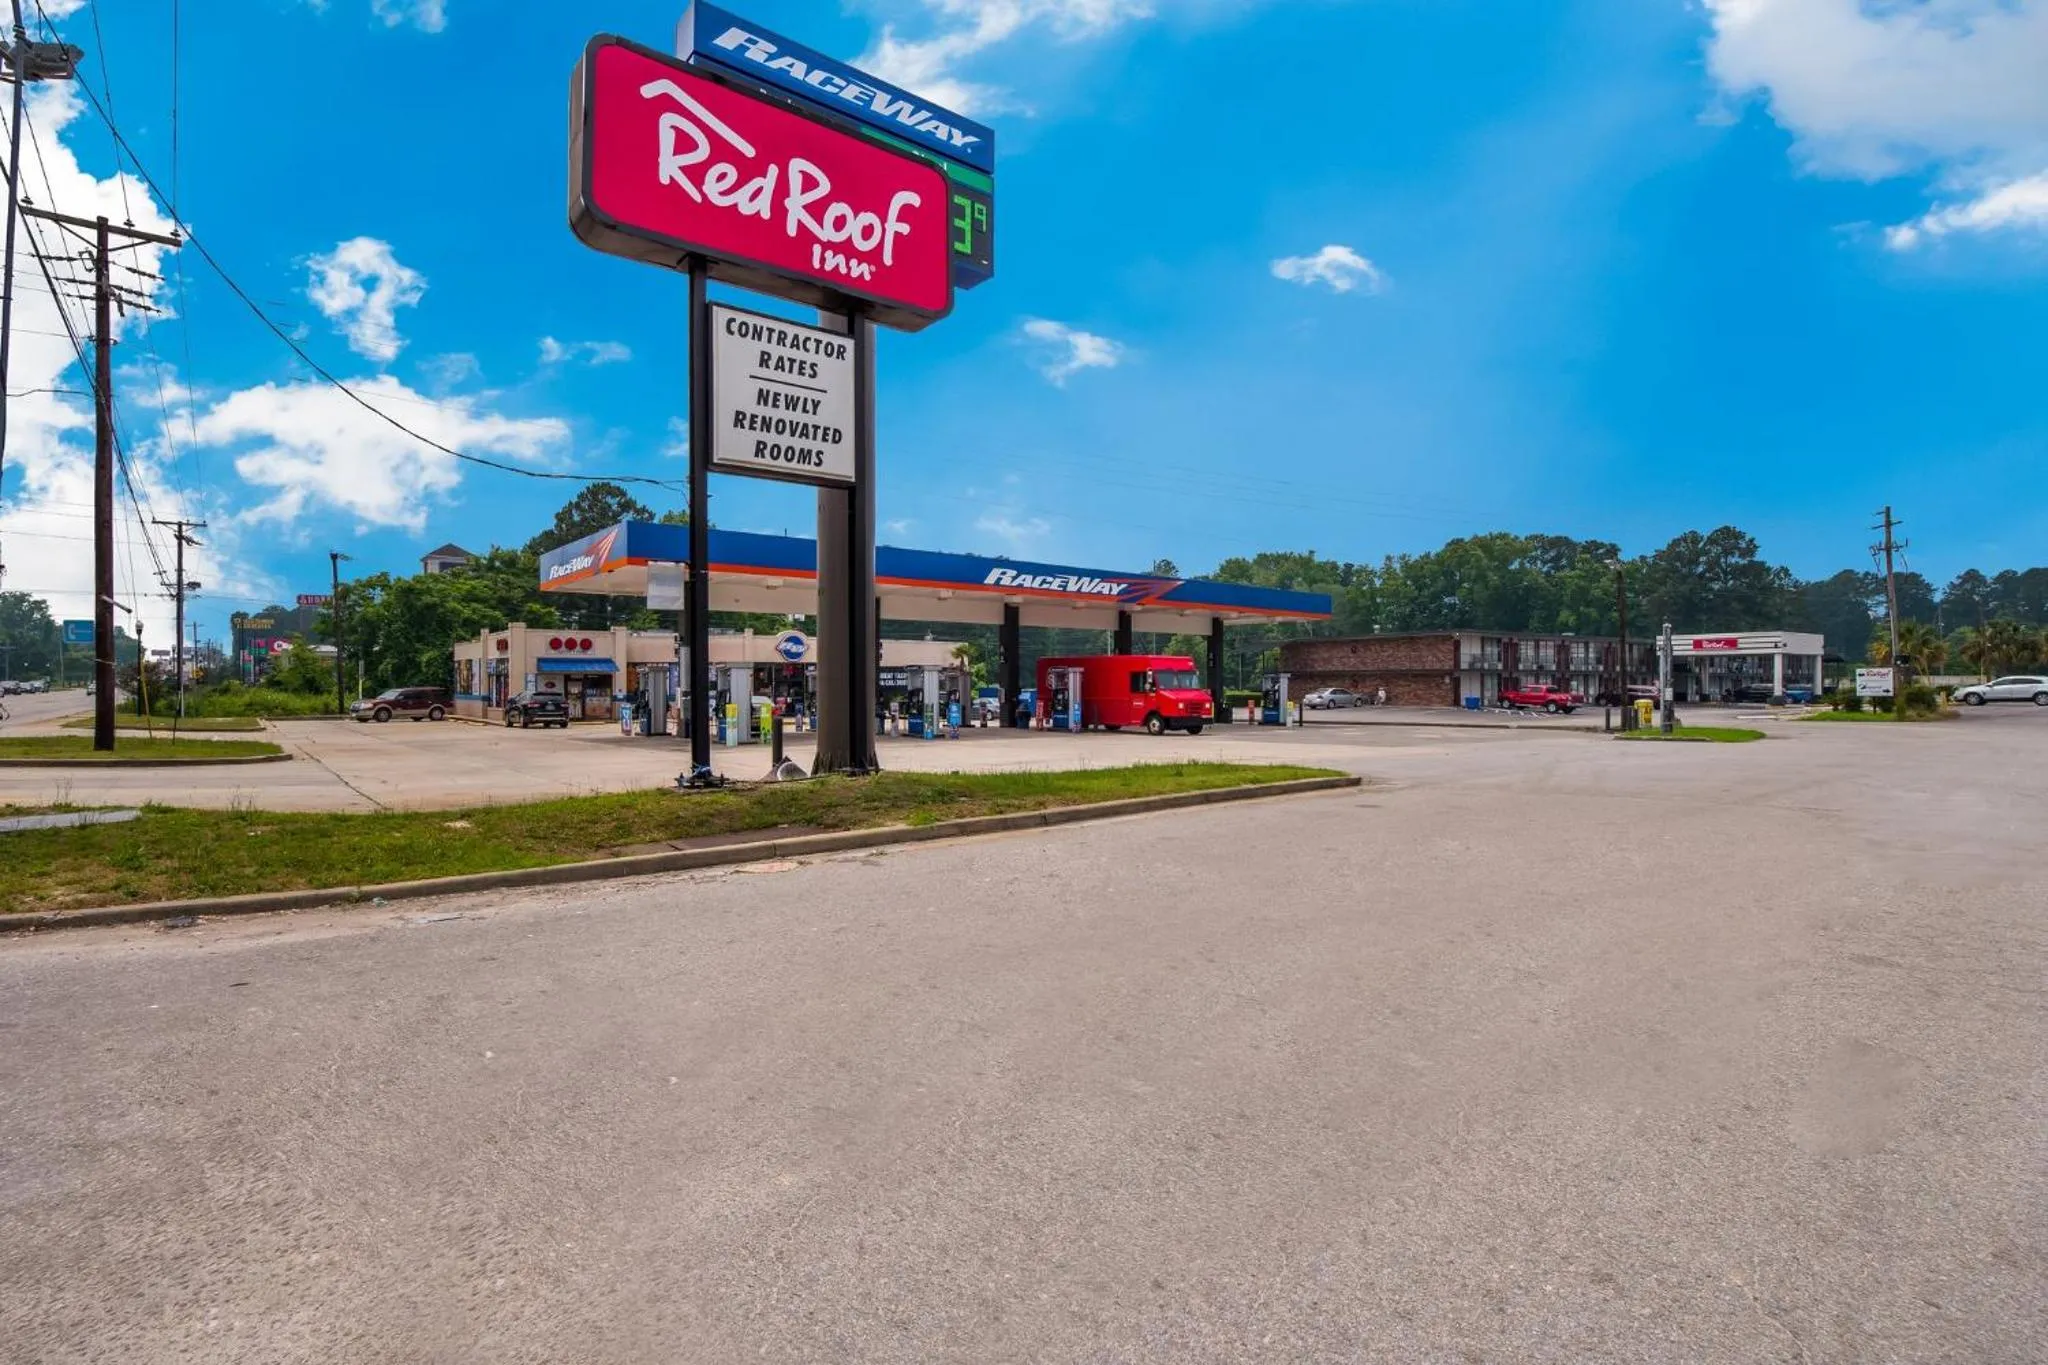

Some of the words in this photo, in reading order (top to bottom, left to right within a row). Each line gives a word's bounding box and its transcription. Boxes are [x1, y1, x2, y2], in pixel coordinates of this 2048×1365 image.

[658, 112, 778, 220] Red
[785, 158, 921, 266] Roof
[725, 317, 848, 361] CONTRACTOR
[758, 350, 819, 379] RATES
[756, 387, 822, 416] NEWLY
[732, 410, 843, 444] RENOVATED
[754, 439, 825, 467] ROOMS
